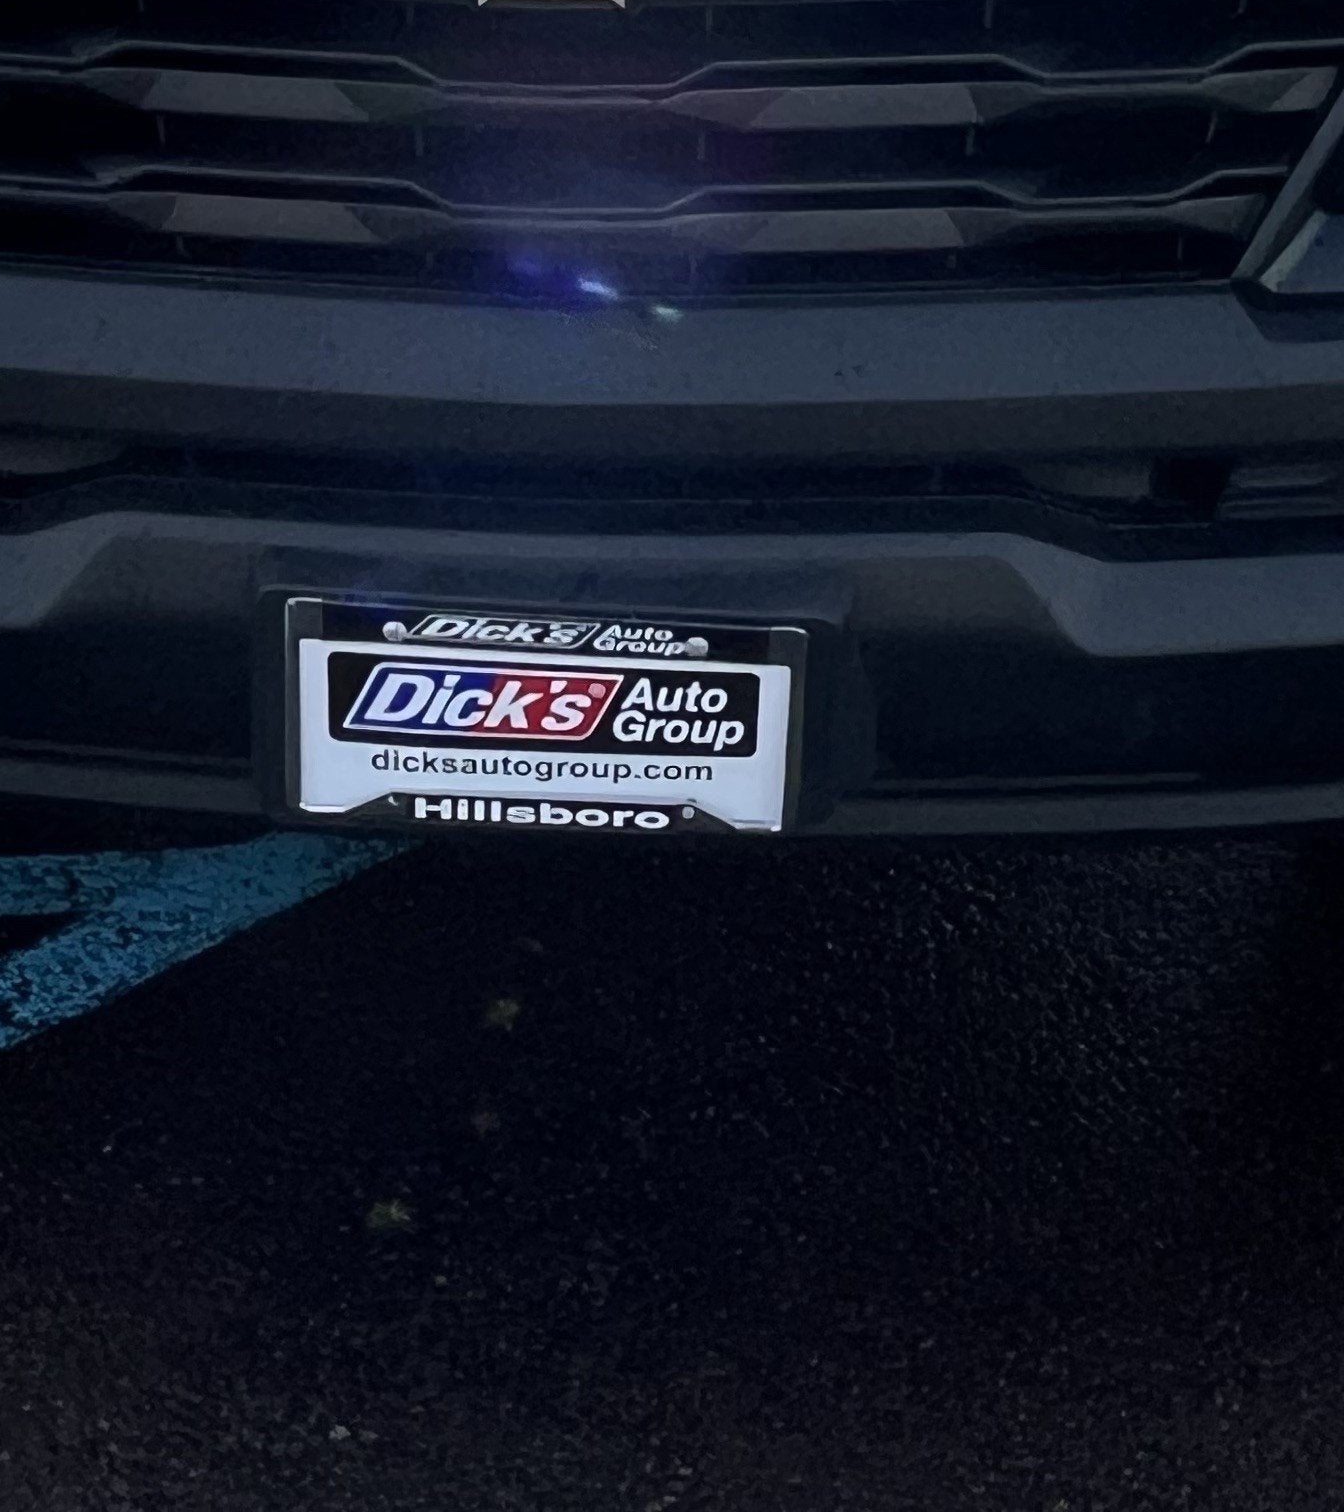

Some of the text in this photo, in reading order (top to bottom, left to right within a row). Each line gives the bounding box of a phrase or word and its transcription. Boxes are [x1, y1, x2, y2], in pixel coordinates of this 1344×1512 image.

[421, 618, 580, 644] Dick's
[592, 637, 687, 657] Group
[600, 624, 674, 641] Auto
[363, 672, 594, 731] Dick's
[620, 678, 728, 713] Auto
[612, 708, 745, 751] Group
[370, 749, 714, 784] dicksautogroup.com
[413, 796, 670, 830] Hillsboro
